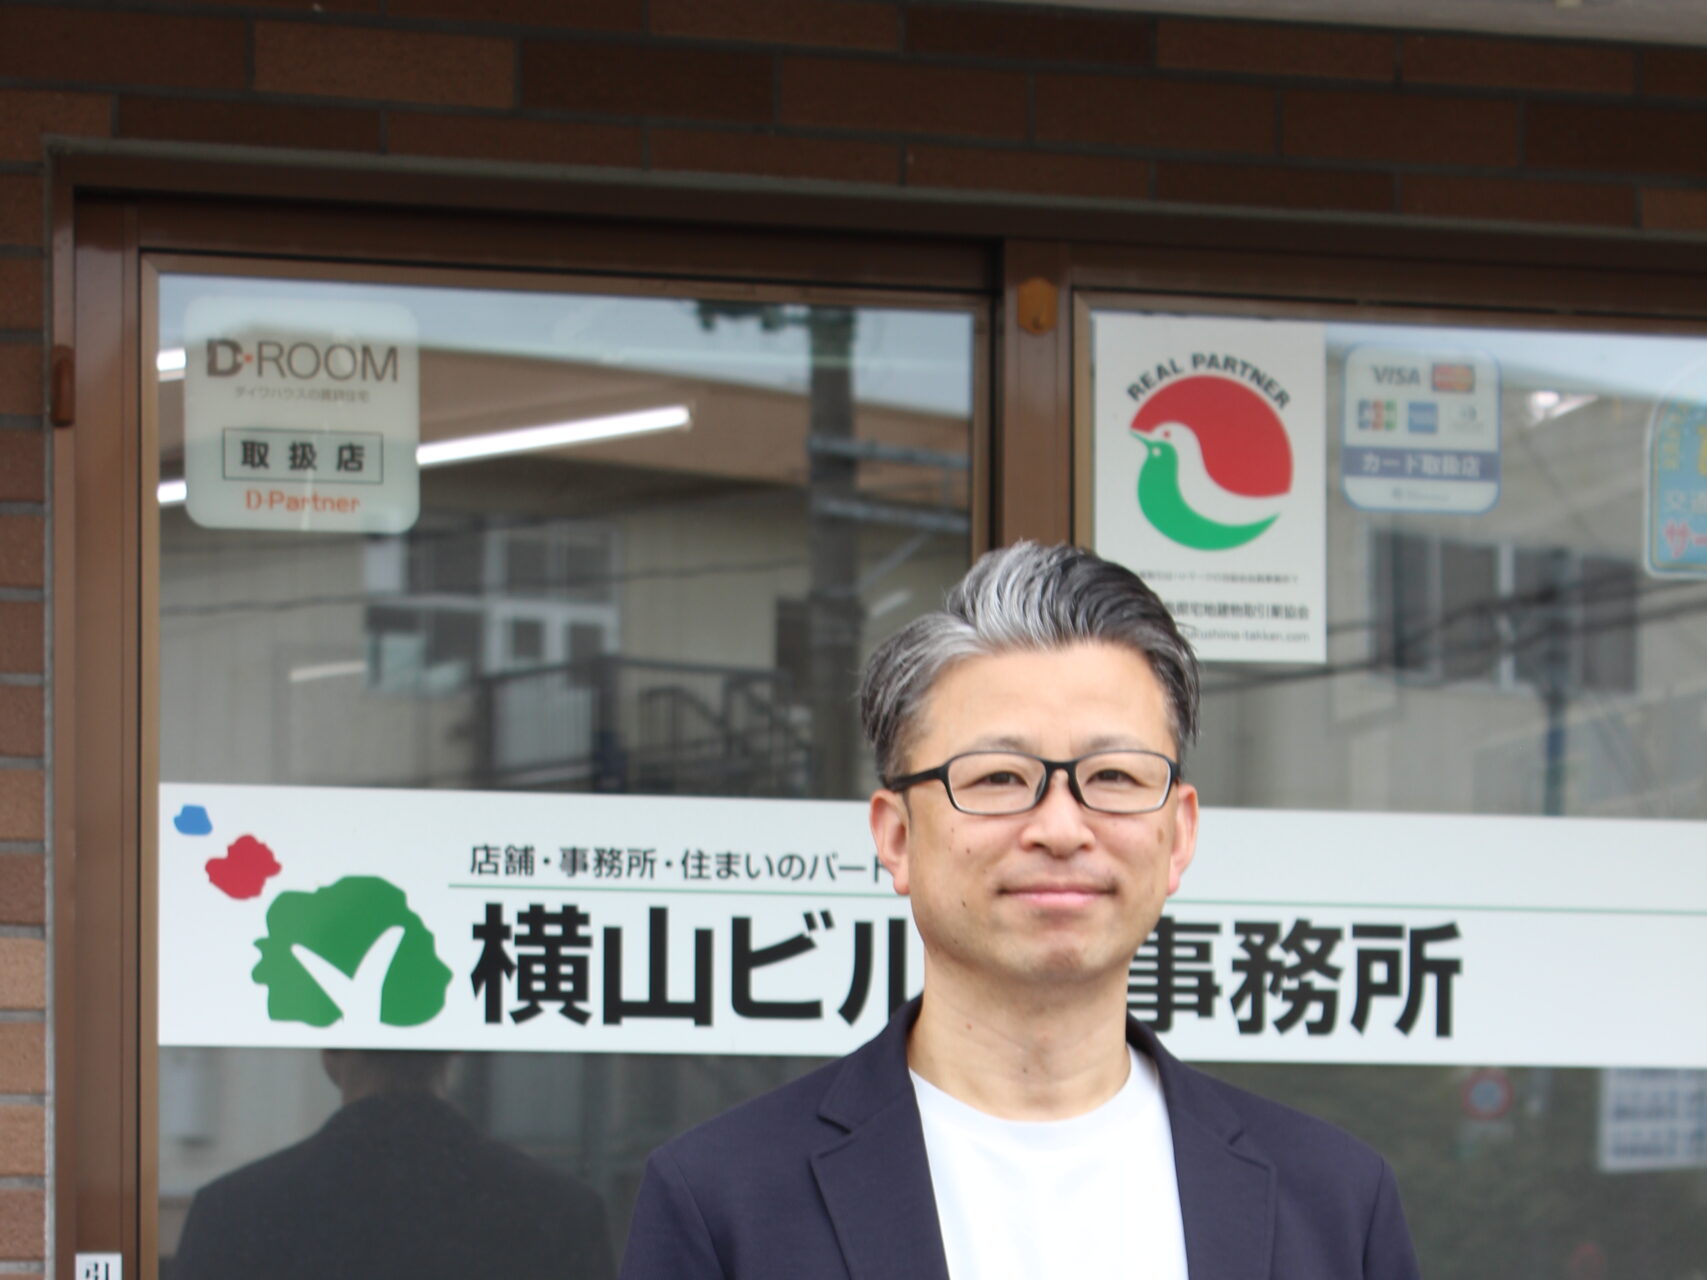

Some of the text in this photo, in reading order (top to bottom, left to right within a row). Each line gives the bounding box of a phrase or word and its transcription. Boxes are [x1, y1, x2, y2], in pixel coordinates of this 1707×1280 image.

[1126, 353, 1292, 409] REAL PARTNER
[1371, 365, 1421, 386] VISA
[241, 440, 365, 472] 取扱店
